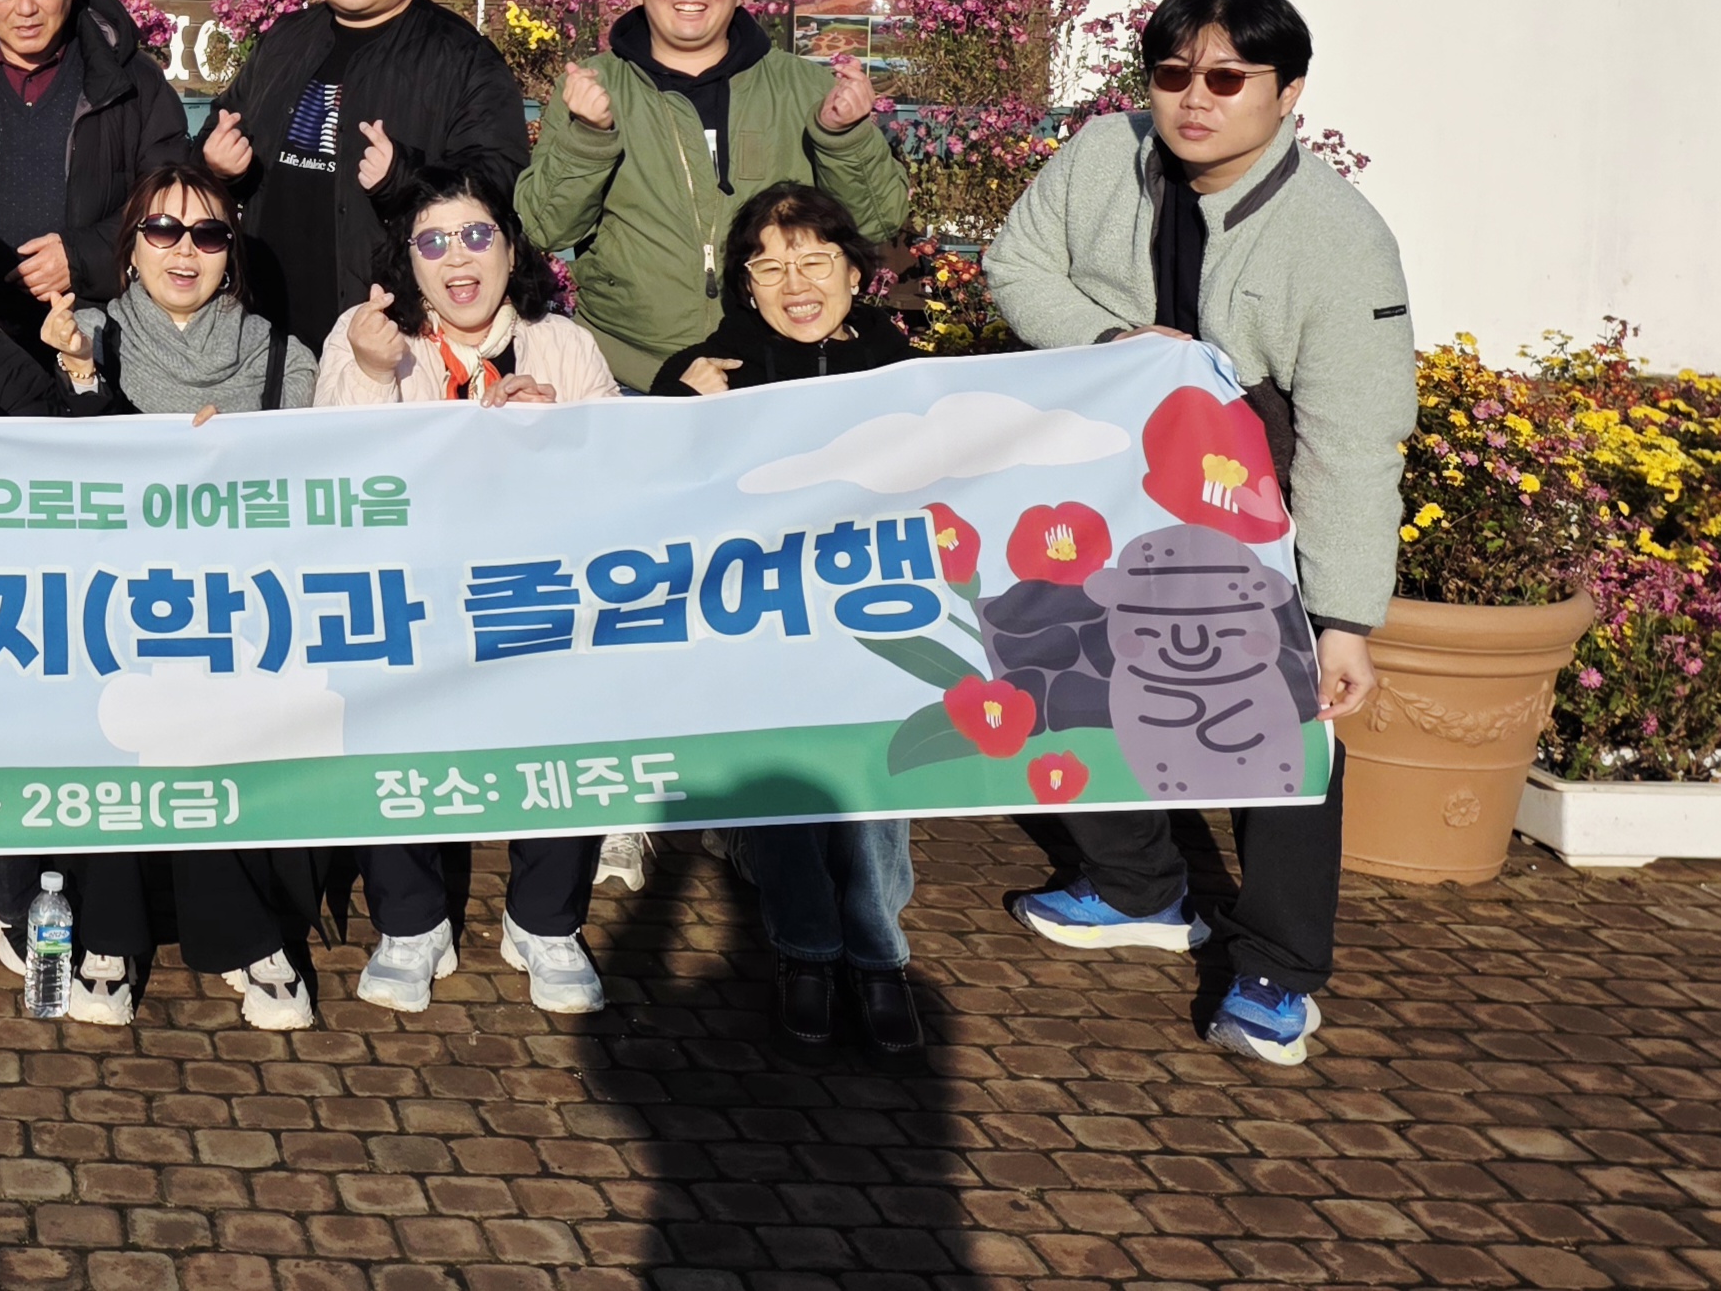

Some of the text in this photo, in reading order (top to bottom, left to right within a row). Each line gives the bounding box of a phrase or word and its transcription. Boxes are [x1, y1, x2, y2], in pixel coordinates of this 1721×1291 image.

[279, 151, 299, 166] Life
[142, 480, 290, 530] 이어질
[304, 475, 411, 529] 마음
[464, 516, 943, 664] 졸업여행
[20, 777, 241, 833] 28일(금)
[375, 752, 687, 819] 장소: 제주도
